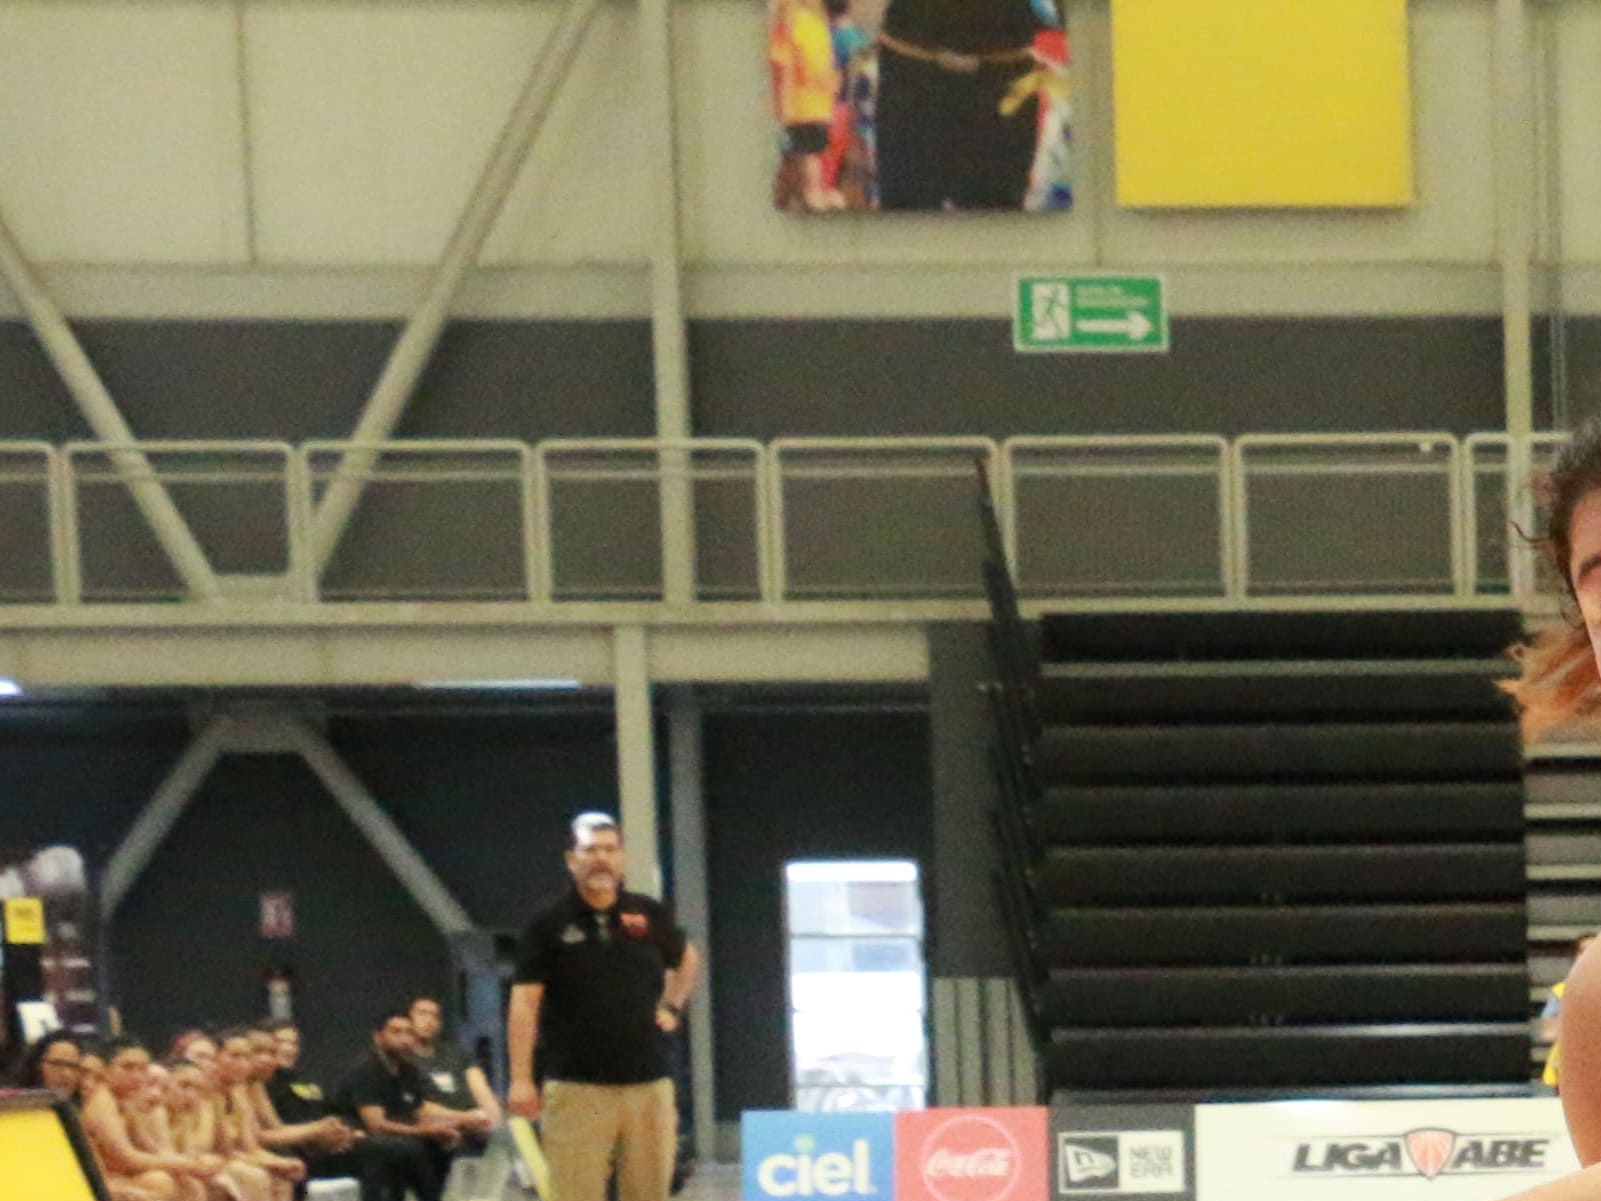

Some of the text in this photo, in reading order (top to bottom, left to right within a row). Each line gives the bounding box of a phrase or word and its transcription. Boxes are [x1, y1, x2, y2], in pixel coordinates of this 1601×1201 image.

[757, 1134, 872, 1197] ciel
[1292, 1138, 1551, 1173] LIGA ABE
